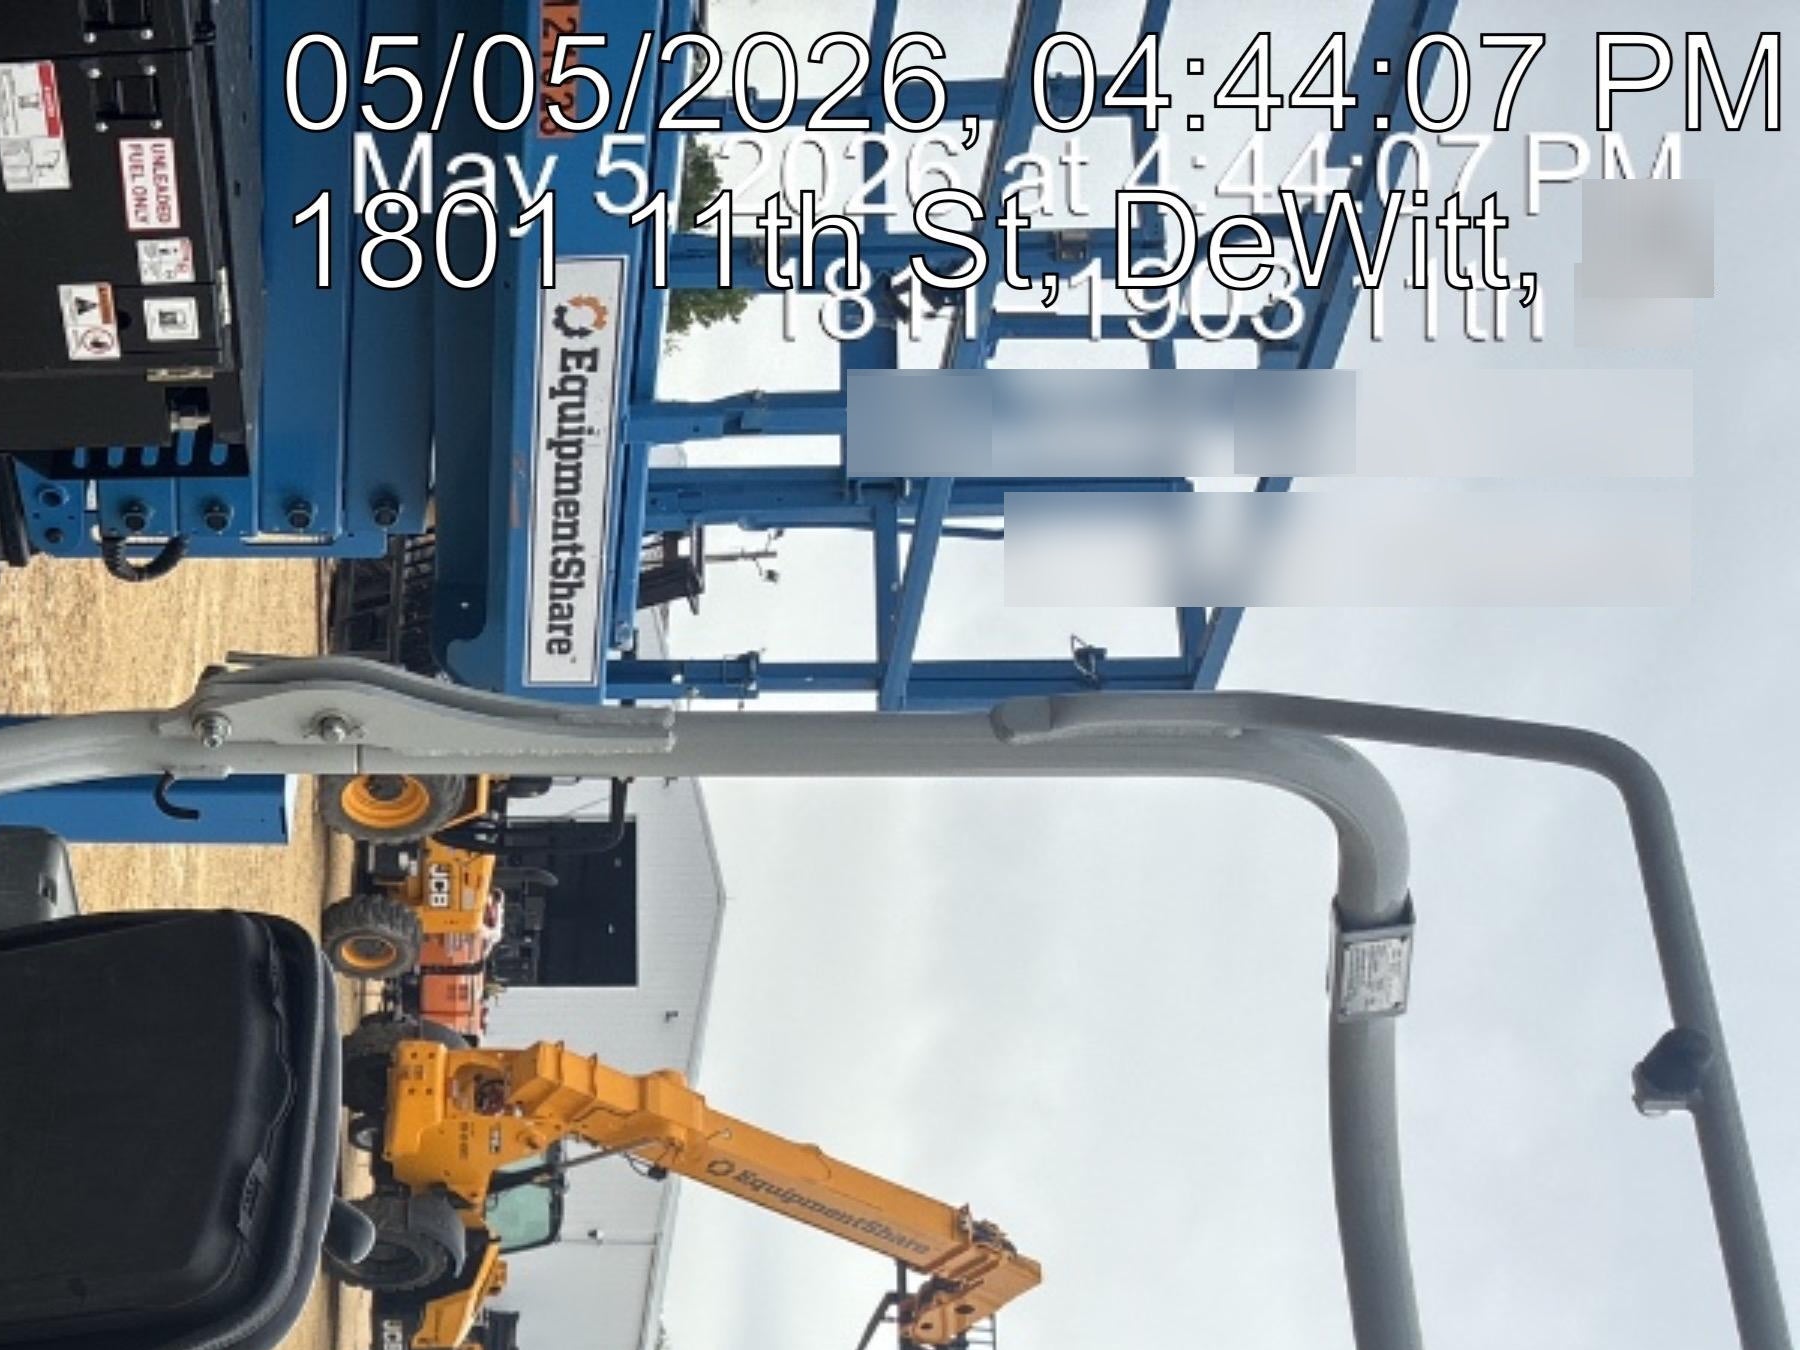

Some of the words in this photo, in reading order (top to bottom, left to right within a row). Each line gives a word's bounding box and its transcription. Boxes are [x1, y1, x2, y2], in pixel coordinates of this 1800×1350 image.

[128, 143, 145, 182] FUEL
[151, 143, 171, 222] UNLEADED
[132, 186, 149, 225] ONLY
[545, 347, 600, 656] EquipmentShare
[428, 864, 449, 909] JCB
[733, 1169, 932, 1256] EquipmentShare
